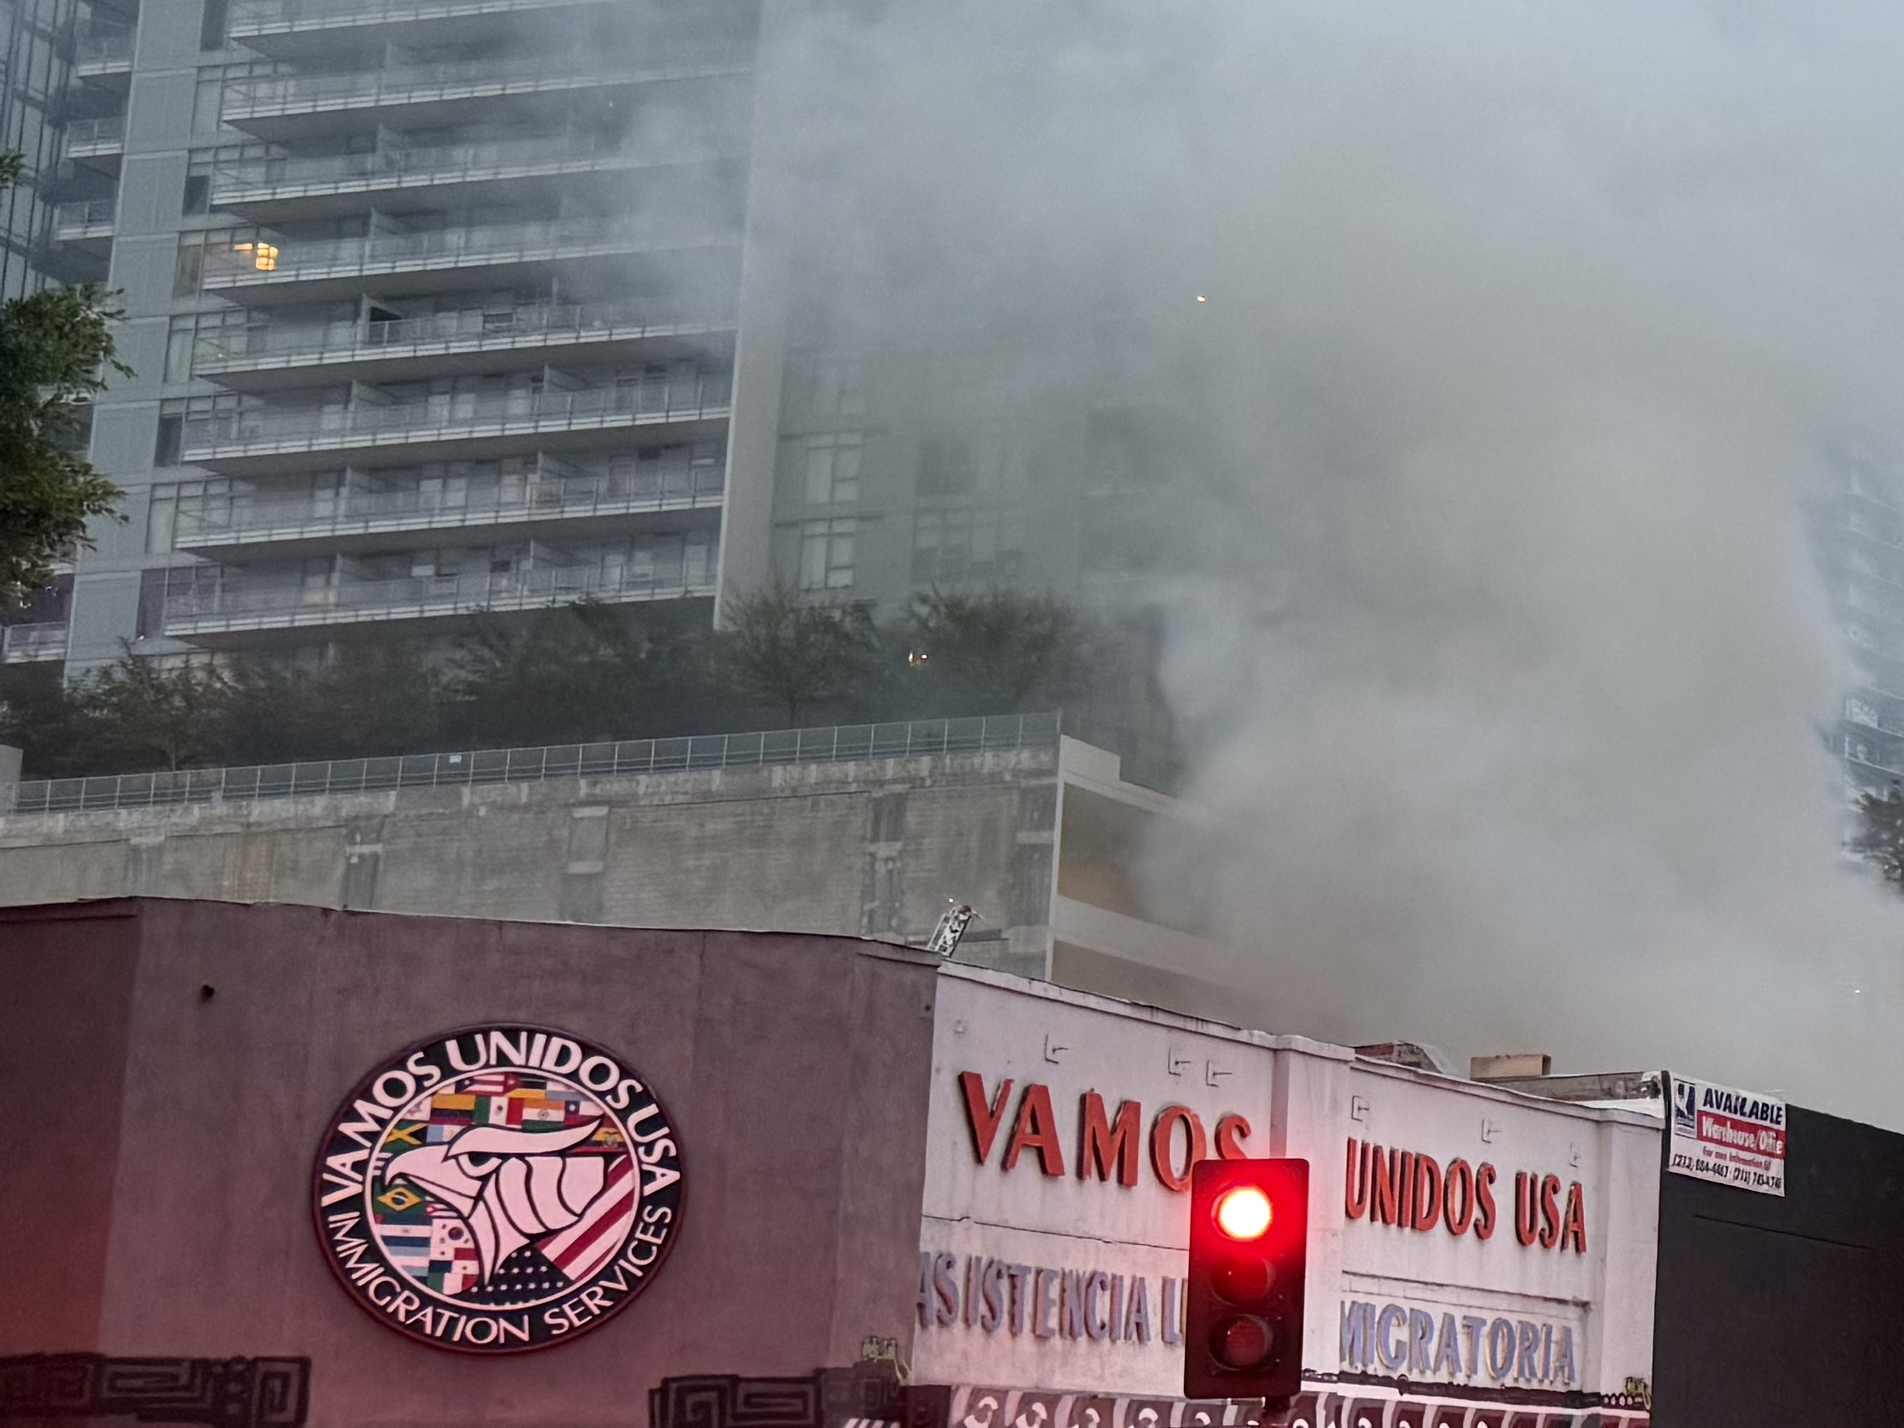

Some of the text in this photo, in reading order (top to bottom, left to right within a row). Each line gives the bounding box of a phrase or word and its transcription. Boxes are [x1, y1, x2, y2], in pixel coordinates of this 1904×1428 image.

[321, 1031, 681, 1207] VAMOS UNIDOS USA
[1702, 1087, 1782, 1125] AVAILABLE
[1345, 1136, 1497, 1240] UNIDOS
[1514, 1169, 1587, 1254] USA
[328, 1205, 673, 1344] IMMIGRATION SERVICES
